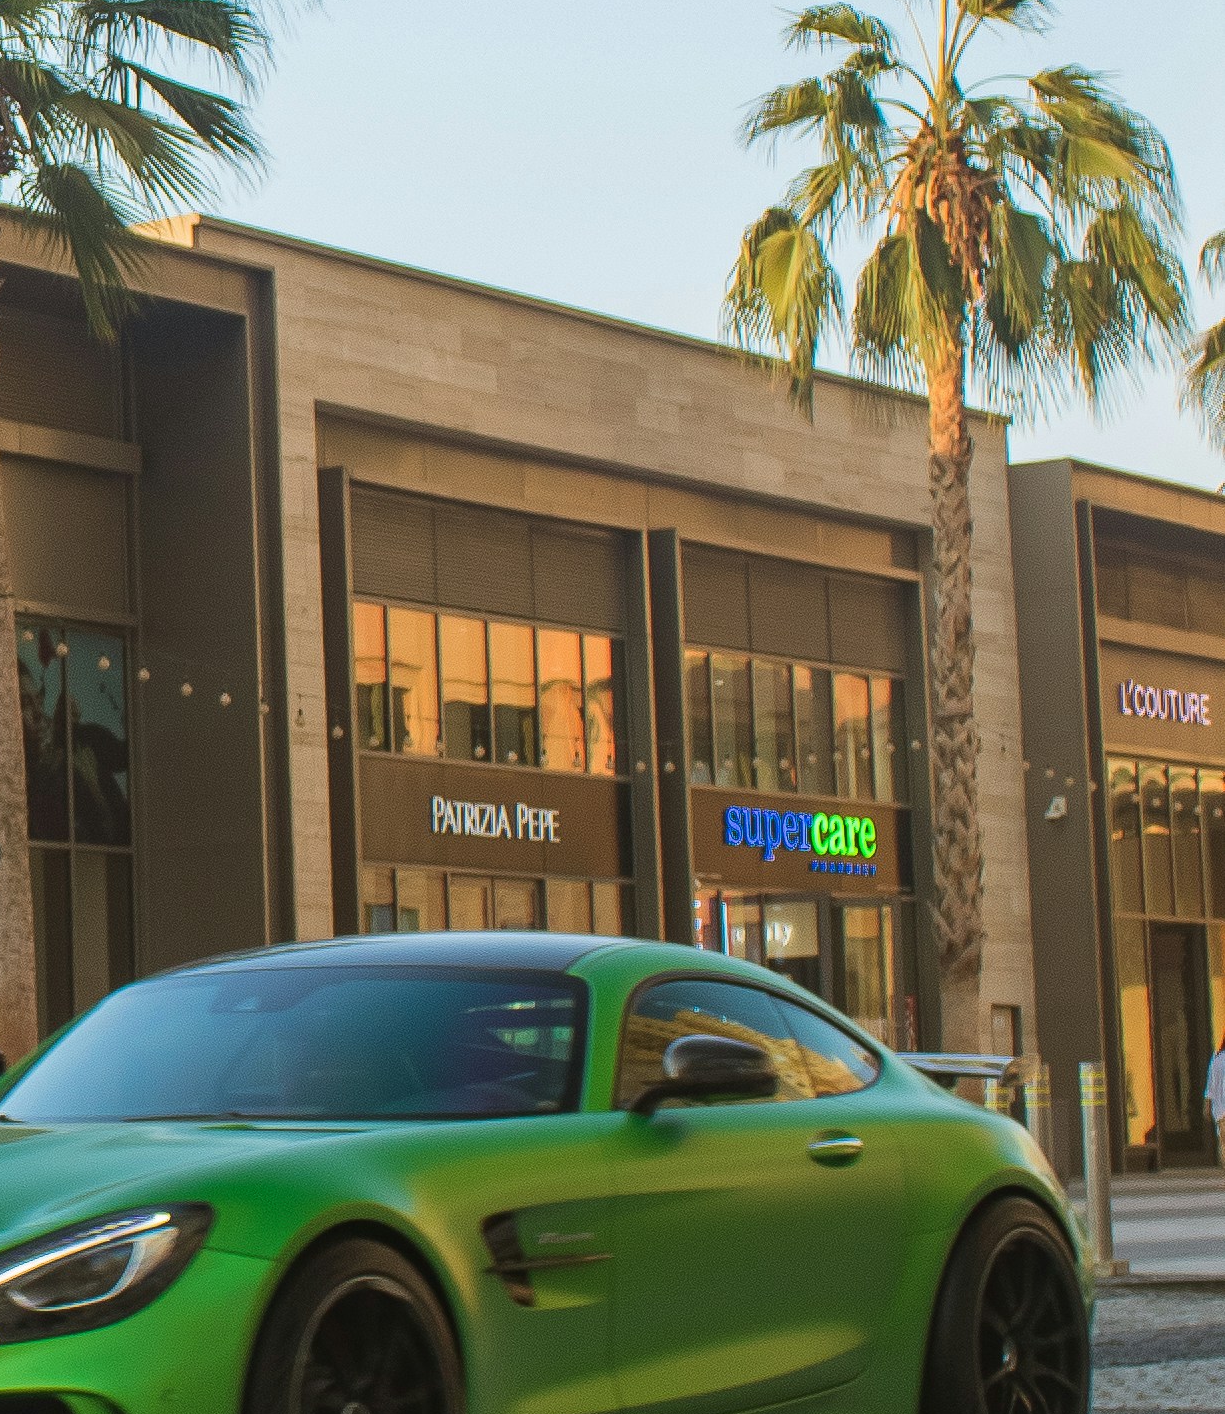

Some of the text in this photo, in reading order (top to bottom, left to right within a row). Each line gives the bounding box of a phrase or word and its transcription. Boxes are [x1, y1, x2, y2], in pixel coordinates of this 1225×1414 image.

[1119, 678, 1212, 726] L'COUTURE
[432, 795, 560, 843] PATRIZIA PEPE
[725, 805, 877, 862] supercare
